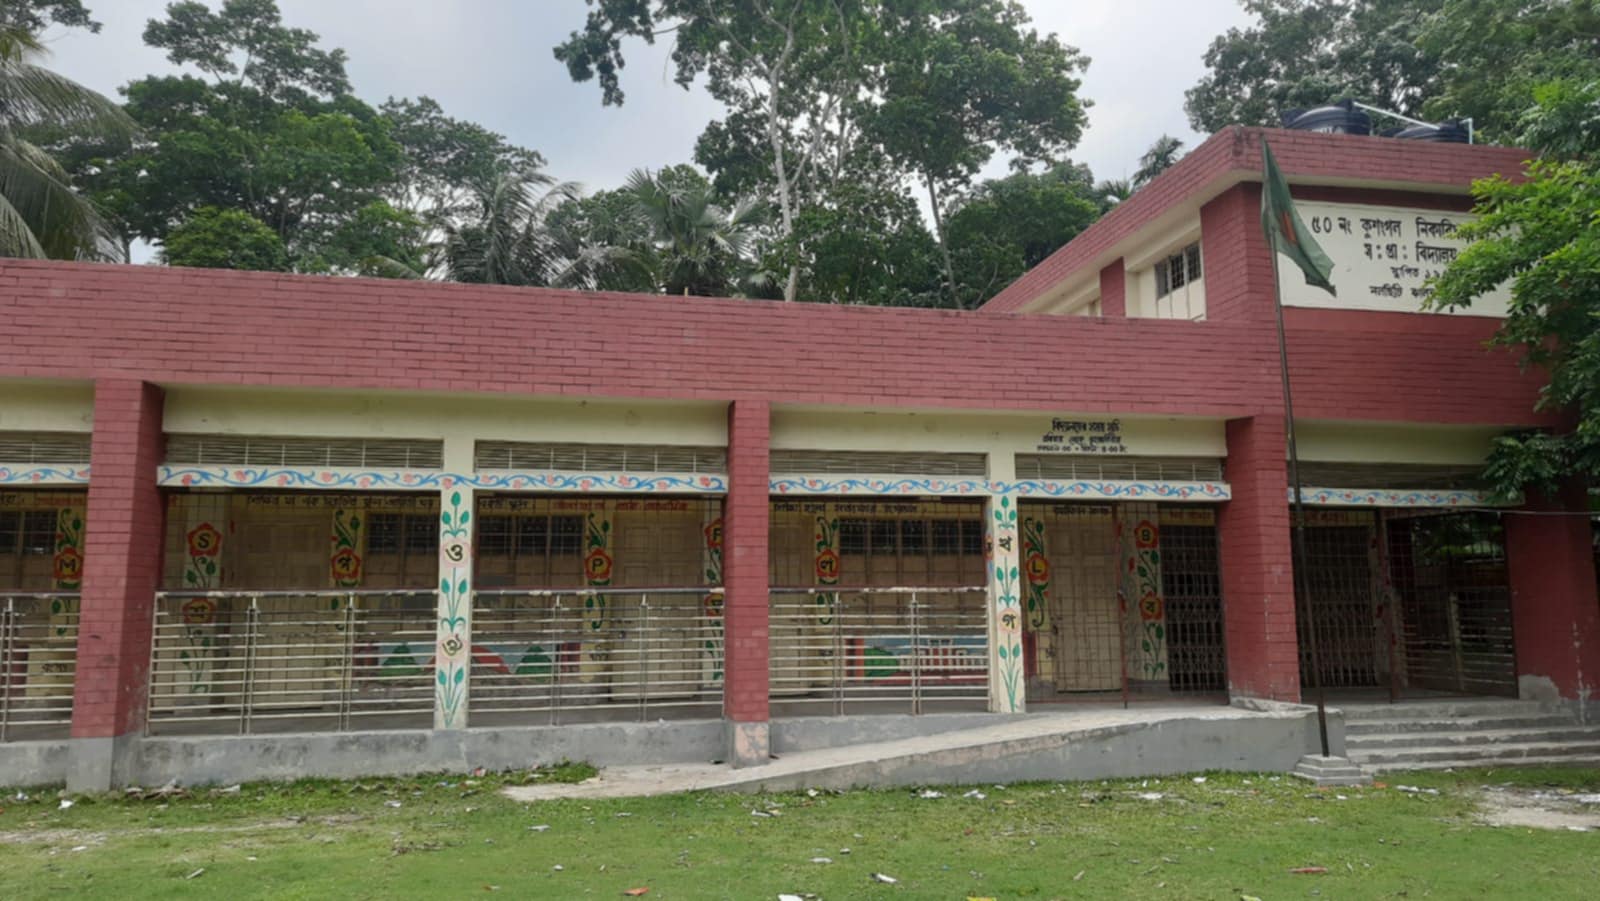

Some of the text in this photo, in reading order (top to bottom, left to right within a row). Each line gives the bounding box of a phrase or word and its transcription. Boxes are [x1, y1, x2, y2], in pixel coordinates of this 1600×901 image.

[1312, 216, 1332, 233] ৫০
[198, 533, 210, 549] S
[445, 544, 463, 562] ও
[61, 558, 76, 573] M
[591, 557, 603, 572] P
